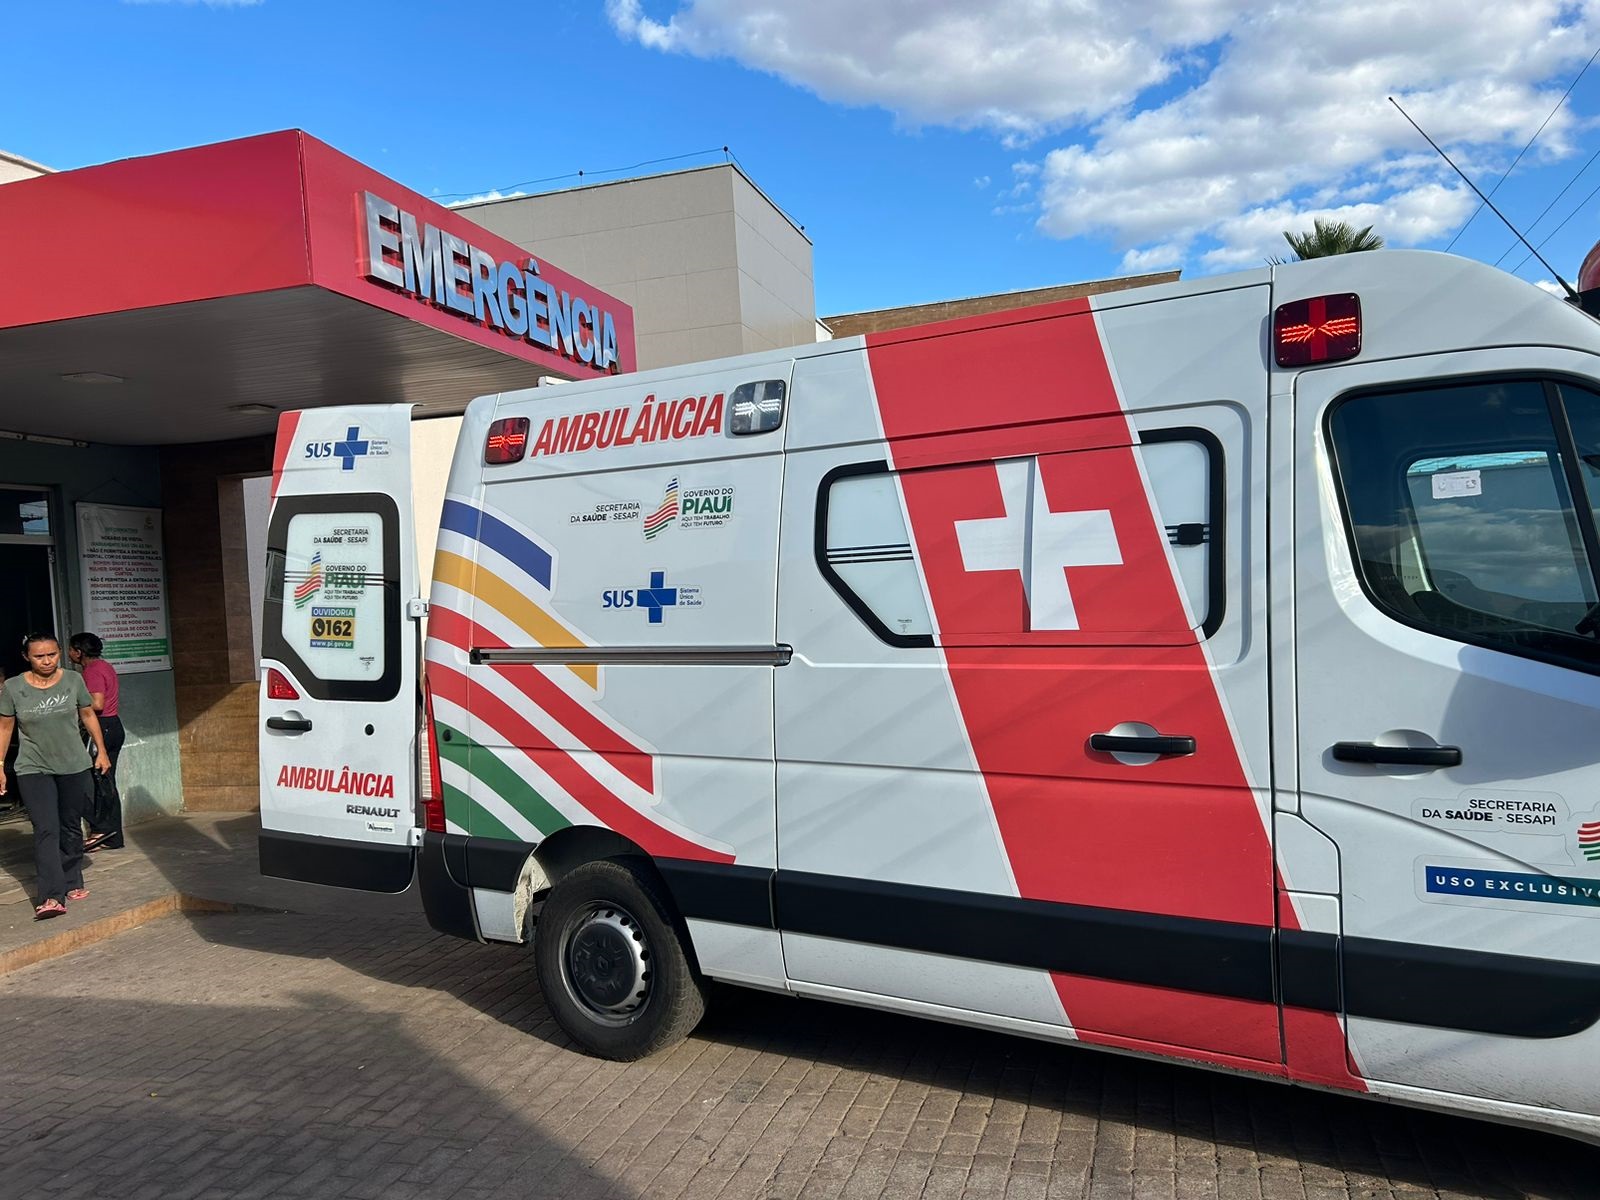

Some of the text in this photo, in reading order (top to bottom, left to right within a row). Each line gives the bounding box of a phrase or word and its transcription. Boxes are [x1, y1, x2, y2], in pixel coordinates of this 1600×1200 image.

[364, 190, 619, 370] EMERGÊNCIA
[530, 393, 725, 457] AMBULÂNCIA
[305, 442, 332, 458] SUS
[683, 488, 720, 498] GOVERNO
[596, 502, 641, 512] SECRETARIA
[682, 495, 732, 514] PIAUÍ
[582, 512, 607, 522] SAÚDE
[613, 512, 639, 520] SESAPI
[322, 536, 343, 544] SAÚDE
[602, 590, 634, 608] SUS
[277, 765, 394, 798] AMBULÂNCIA
[346, 804, 400, 818] RENAULT
[1469, 799, 1557, 813] SECRETARIA
[1422, 808, 1442, 819] DA
[1445, 808, 1493, 822] SAÚDE
[1506, 813, 1556, 826] SESAPI
[1436, 875, 1600, 898] USO EXCLUSIV
